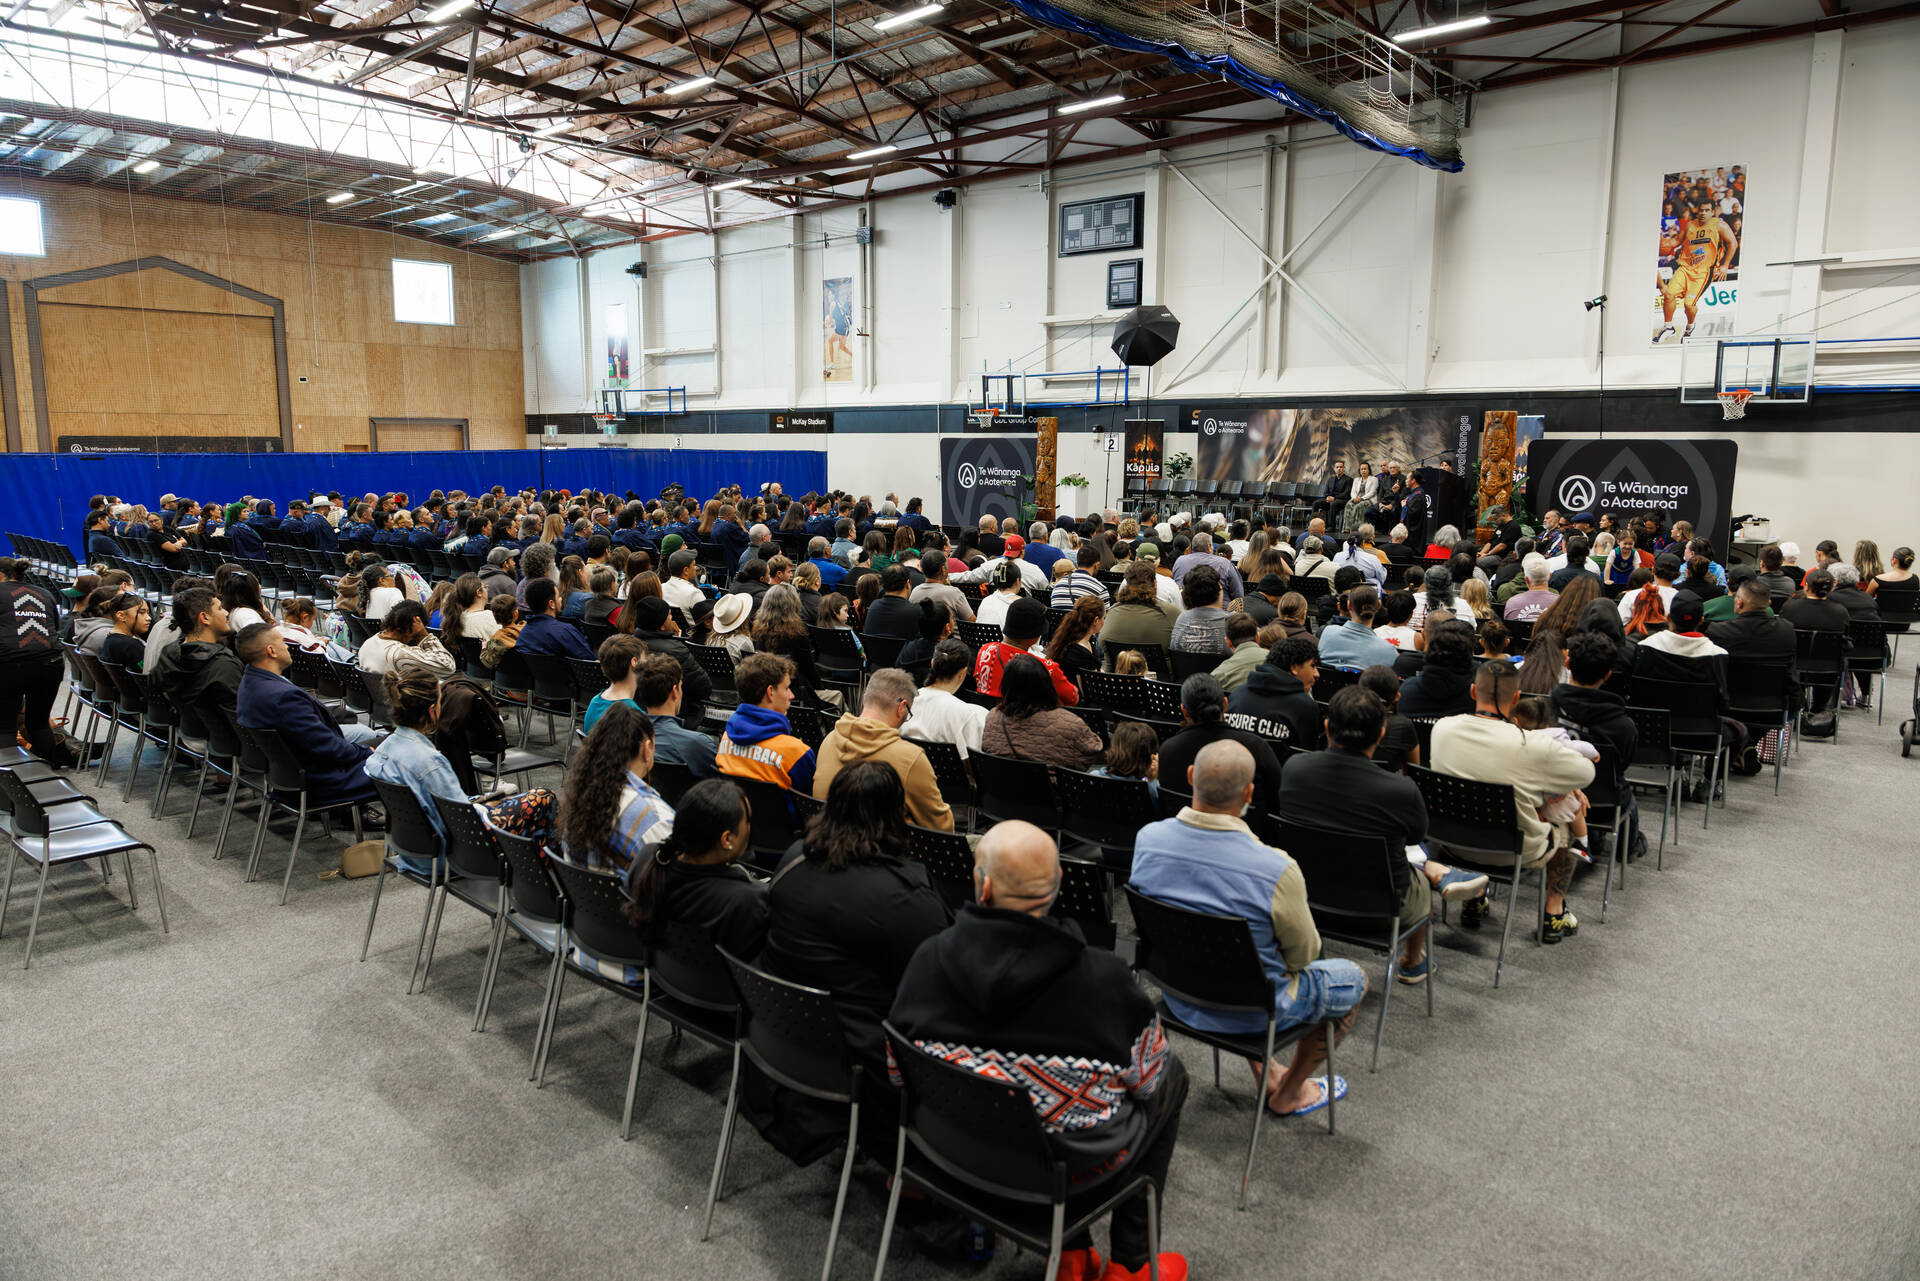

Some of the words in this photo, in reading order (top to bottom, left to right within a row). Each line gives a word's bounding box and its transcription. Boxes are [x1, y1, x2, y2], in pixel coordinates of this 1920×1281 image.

[1695, 230, 1706, 239] 10
[791, 418, 807, 427] McKay
[1108, 439, 1115, 450] 2
[1456, 415, 1472, 477] waitanga
[978, 467, 987, 476] Te
[987, 467, 1021, 479] Wānanga
[984, 478, 1017, 487] Aotearoa
[1601, 481, 1616, 493] Te
[1619, 481, 1688, 498] Wānanga
[1600, 498, 1610, 508] o
[1611, 496, 1678, 510] Aotearoa
[1223, 713, 1258, 732] EISURE
[1258, 718, 1290, 739] CLUB
